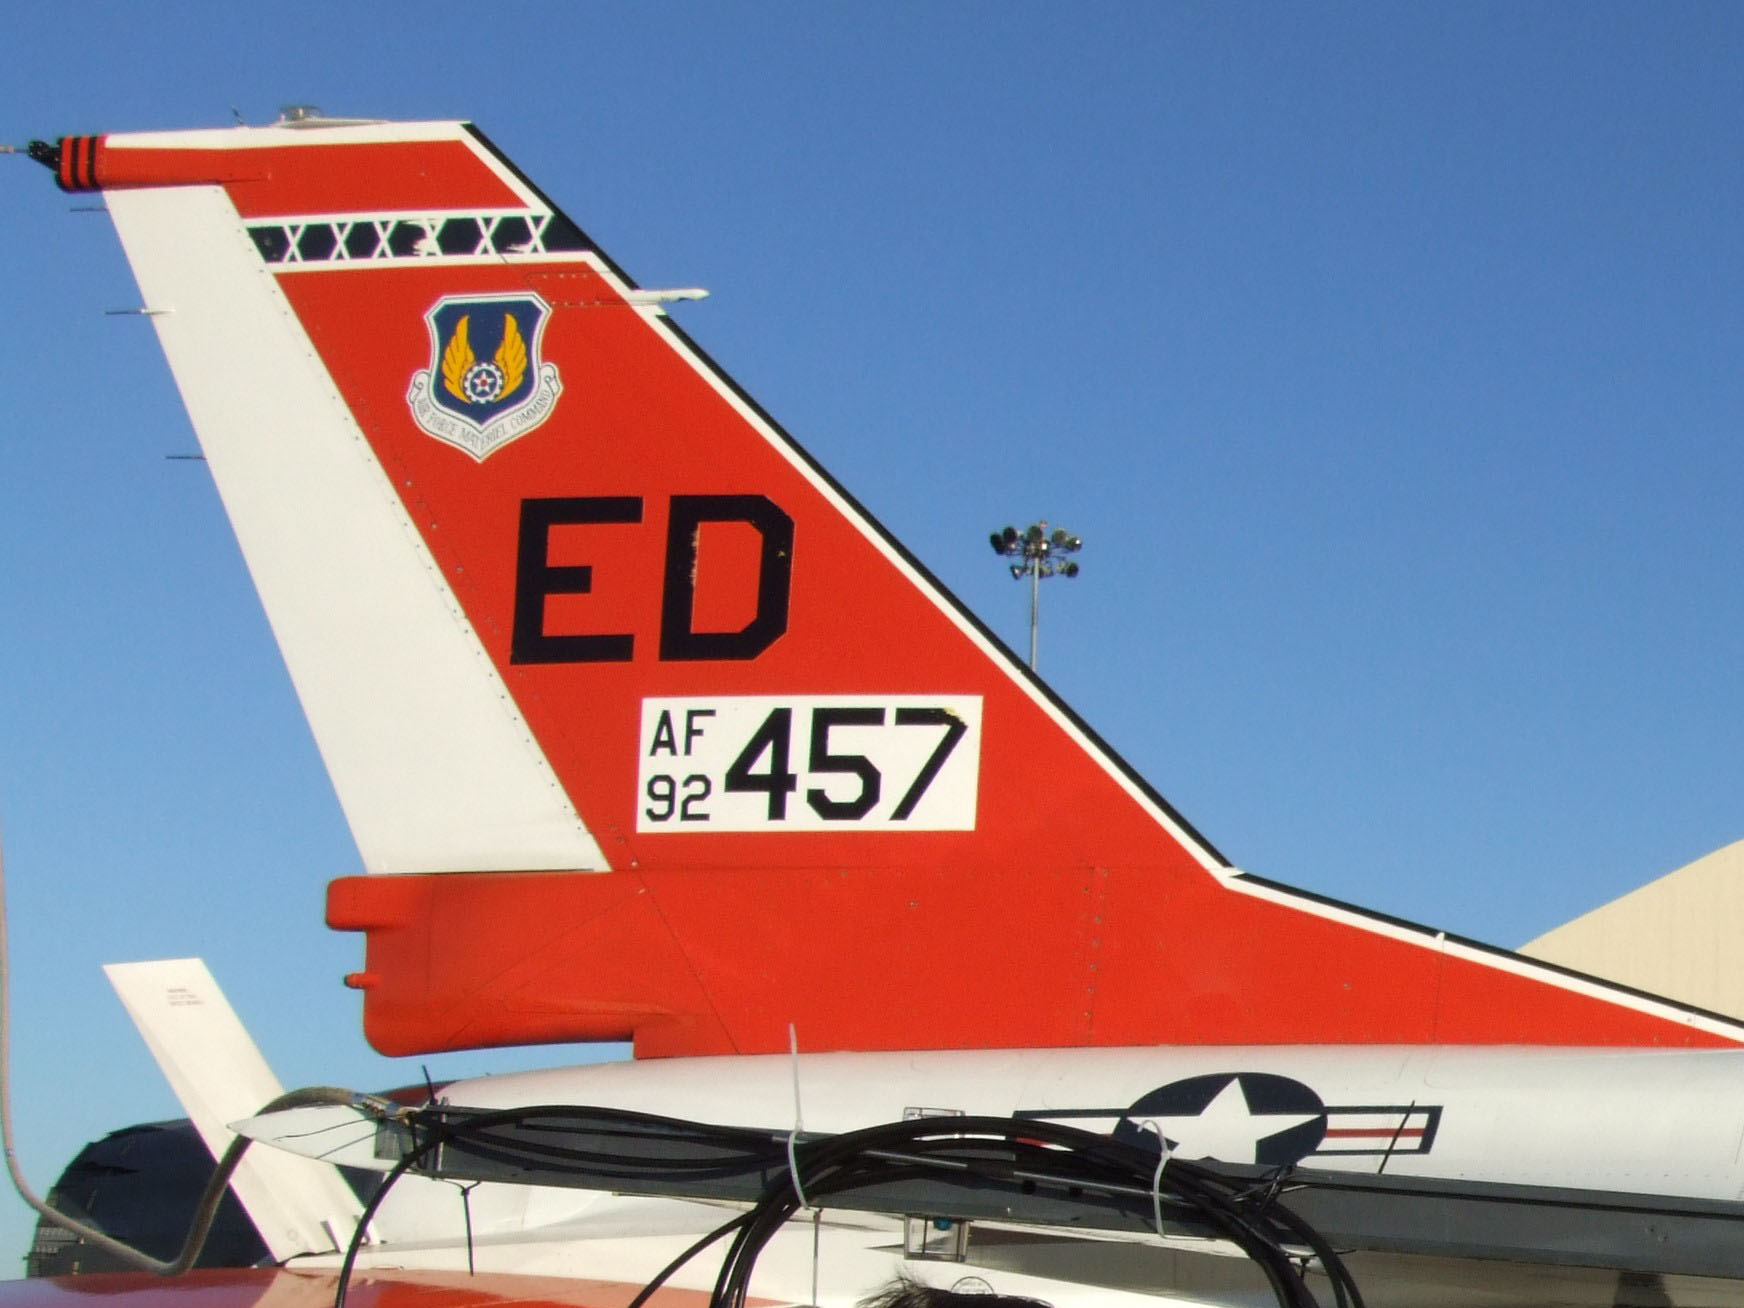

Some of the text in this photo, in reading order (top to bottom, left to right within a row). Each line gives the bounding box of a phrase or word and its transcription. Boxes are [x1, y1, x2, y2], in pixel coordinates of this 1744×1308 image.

[510, 494, 795, 666] ED
[650, 708, 716, 757] AF
[724, 706, 968, 821] 457
[646, 773, 711, 822] 92
